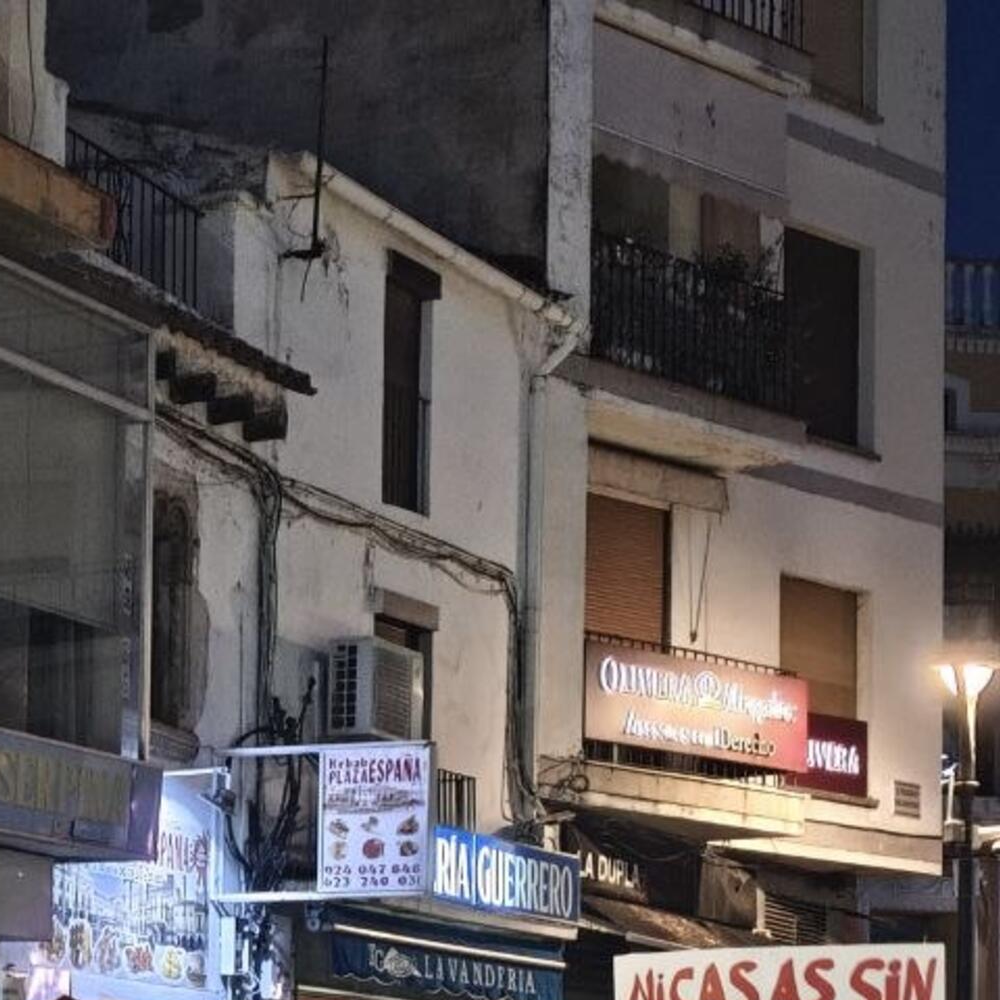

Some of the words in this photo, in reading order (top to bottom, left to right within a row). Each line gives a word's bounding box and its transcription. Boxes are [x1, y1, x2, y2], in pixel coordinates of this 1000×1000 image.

[329, 770, 368, 784] PLAZA
[369, 754, 421, 783] ESPAÑA
[478, 846, 572, 918] GUERRERO
[424, 955, 536, 994] LAVANDERIA
